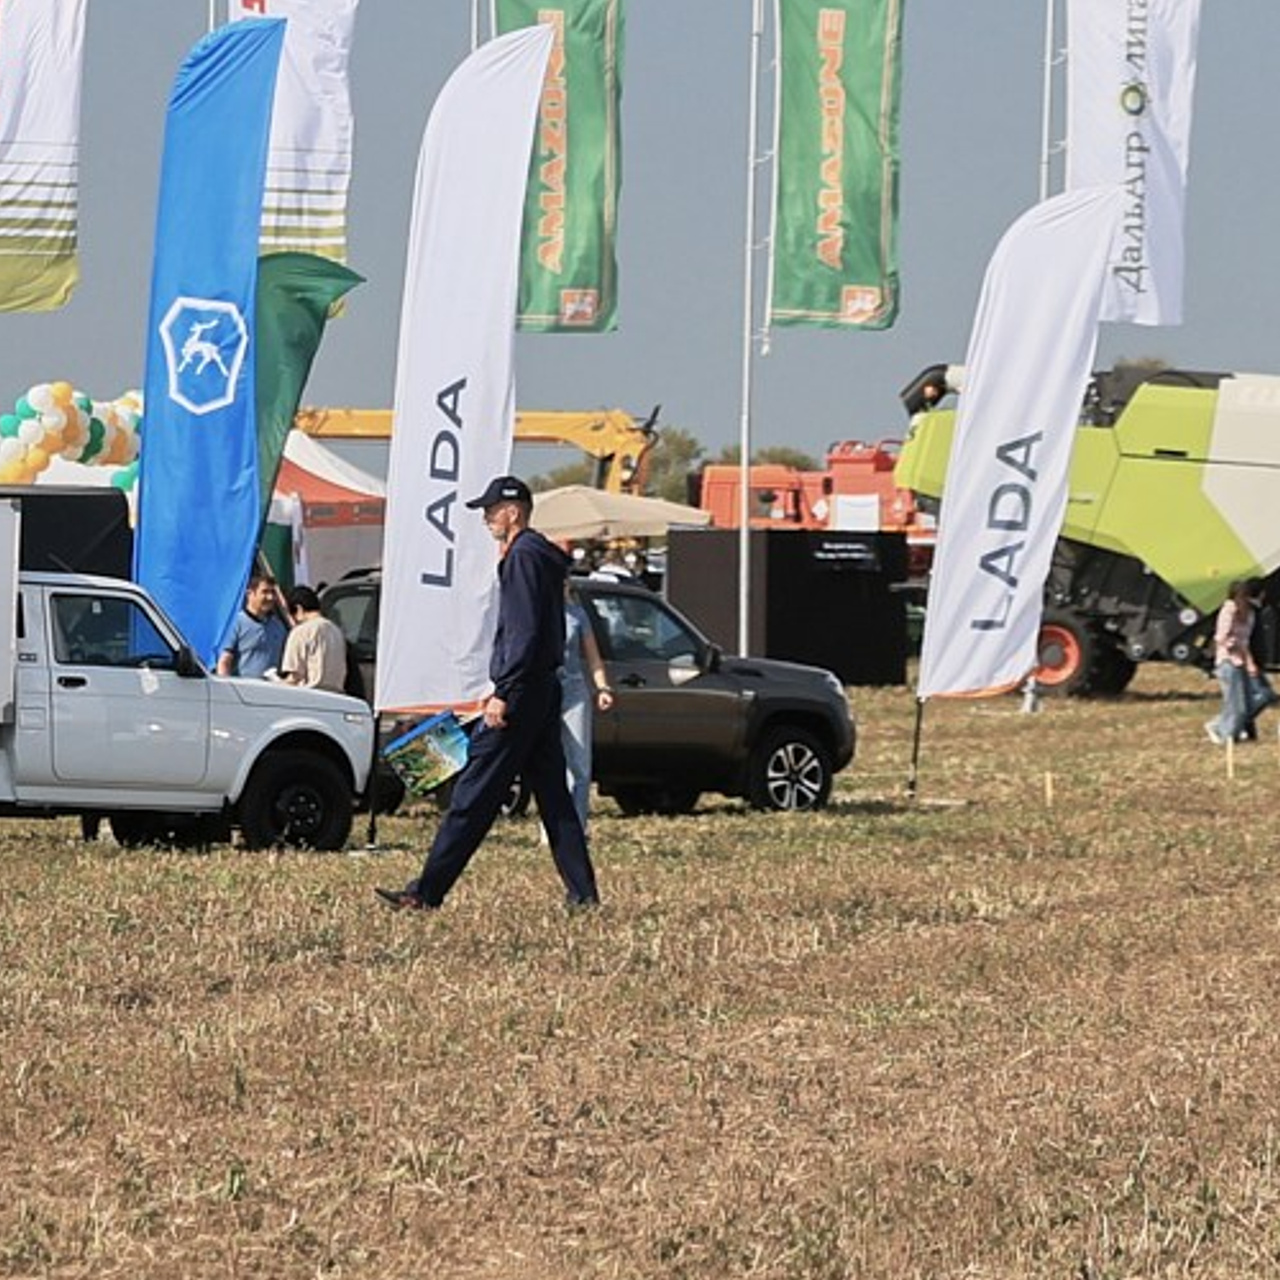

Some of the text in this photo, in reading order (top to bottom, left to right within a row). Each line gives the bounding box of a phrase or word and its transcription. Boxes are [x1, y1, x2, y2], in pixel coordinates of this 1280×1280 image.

[816, 8, 846, 270] AMAZONE
[421, 376, 467, 588] LADA
[970, 431, 1043, 633] LADA
